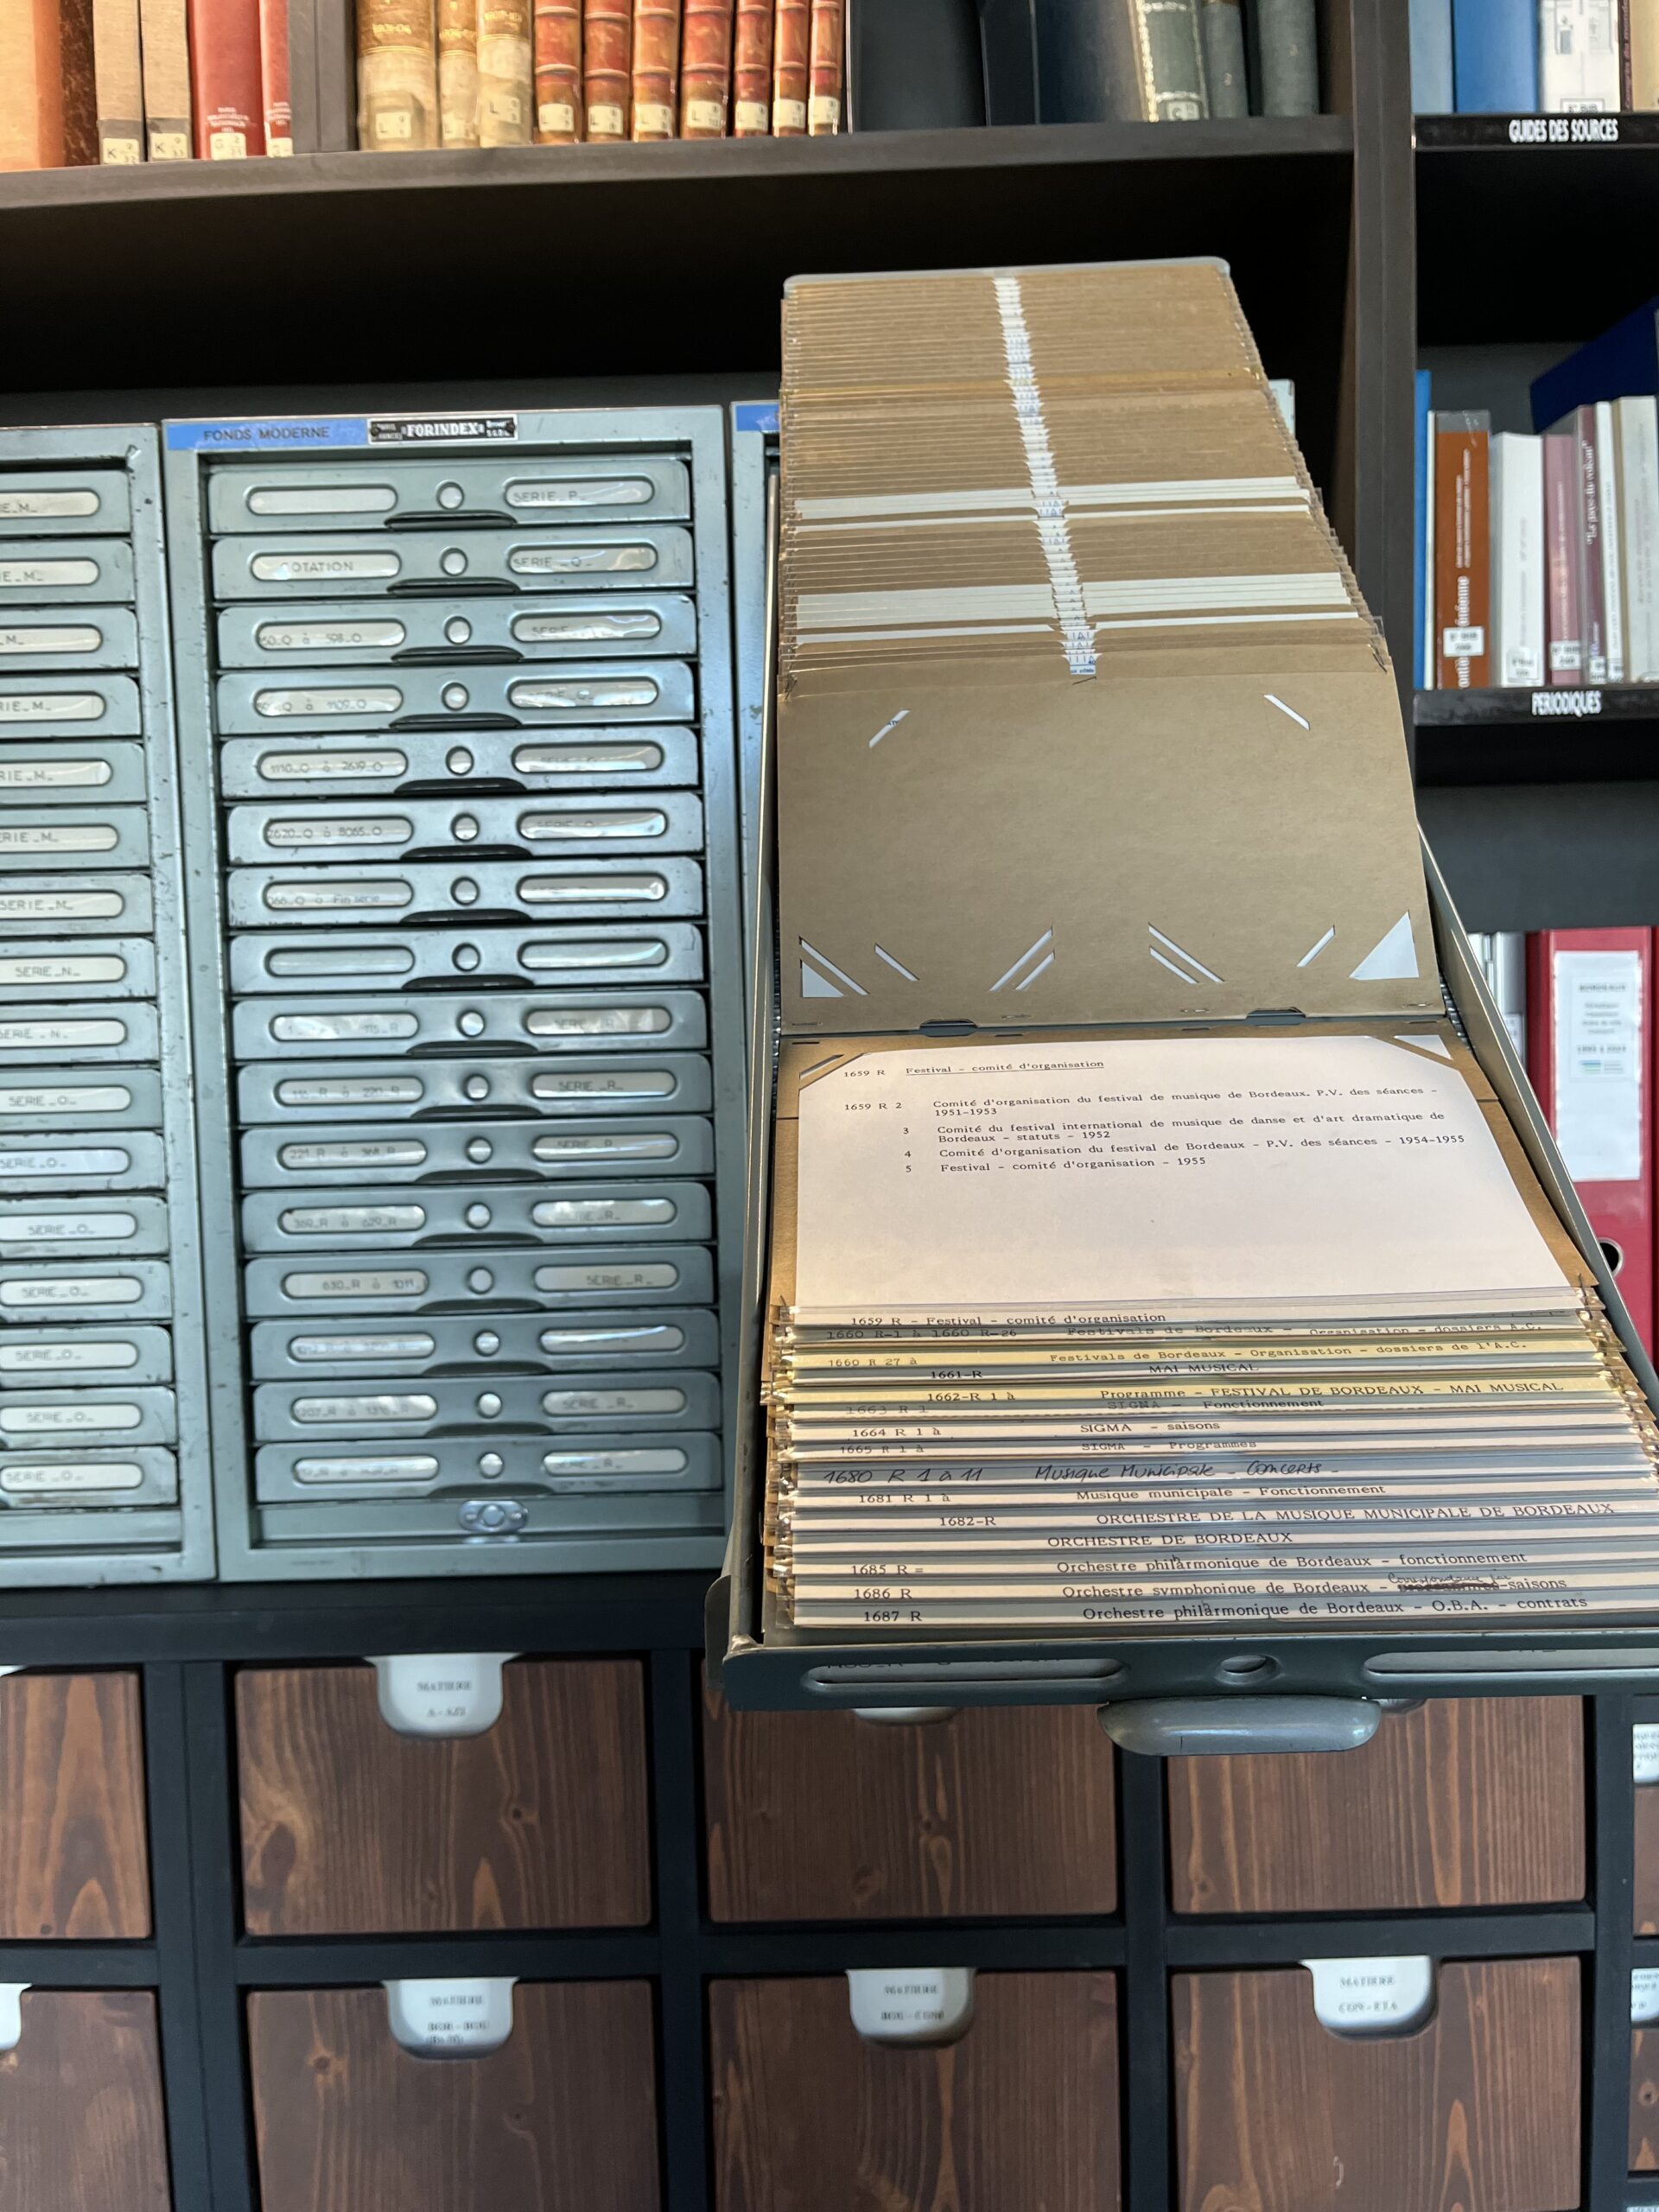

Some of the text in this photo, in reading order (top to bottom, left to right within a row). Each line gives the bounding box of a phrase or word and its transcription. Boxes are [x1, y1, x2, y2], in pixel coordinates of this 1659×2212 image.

[1509, 118, 1618, 143] GUIDES DES SOURCES
[203, 426, 330, 442] FONDS MODERNE
[406, 422, 480, 438] FORINDEX
[843, 1069, 870, 1077] 1659
[906, 1065, 951, 1075] Festival
[971, 1063, 1013, 1072] comité
[1020, 1059, 1104, 1071] d'organisation
[844, 1103, 872, 1111] 1659
[933, 1099, 977, 1109] Comité
[983, 1096, 1071, 1107] d'organisation
[1077, 1095, 1091, 1103] du
[1098, 1093, 1143, 1103] festival
[1150, 1093, 1165, 1102] de
[1171, 1091, 1221, 1102] musique
[1228, 1090, 1243, 1098] de
[1249, 1089, 1311, 1098] Bordeaux.
[1376, 1086, 1424, 1096] séances
[935, 1107, 997, 1116] 1951-1953
[937, 1125, 982, 1134] Comité
[988, 1124, 1003, 1133] du
[1010, 1122, 1055, 1132] festival
[1062, 1120, 1142, 1130] international
[1150, 1119, 1165, 1128] de
[1172, 1117, 1223, 1128] musique
[1250, 1116, 1286, 1125] danse
[1293, 1115, 1305, 1123] et
[1313, 1114, 1344, 1123] d'art
[1351, 1112, 1423, 1123] dramatique
[1429, 1111, 1445, 1120] de
[938, 1130, 1111, 1143] Bordeaux statuts 1952
[939, 1135, 1465, 1158] Comité d'organisation du festival de Bordeaux P.V. des séances 1954-1955
[940, 1156, 1206, 1173] Festival comité d'organisation 1955
[851, 1313, 1166, 1326] 1659 R Festival comité d'organisation
[829, 1358, 860, 1367] 1660
[885, 1357, 900, 1366] 27
[910, 1357, 918, 1365] à
[1050, 1352, 1125, 1362] Festivals
[1133, 1351, 1150, 1360] de
[1159, 1349, 1225, 1359] Bordeaux
[1250, 1346, 1352, 1358] Organisation
[1376, 1344, 1444, 1353] dossiers
[1452, 1342, 1469, 1351] de
[931, 1363, 1260, 1379] 1661-R MAI MUSICAL
[927, 1382, 1565, 1402] 1662-R 1 à Programme FESTIVAL DE BORDEAUX MAI MUSICAL
[852, 1428, 886, 1438] 1664
[916, 1427, 924, 1436] 1
[932, 1427, 942, 1436] à
[1080, 1423, 1133, 1433] SIGMA
[1166, 1421, 1220, 1431] saisons
[823, 1469, 873, 1484] 1680
[887, 1468, 906, 1484] R
[916, 1468, 931, 1482] 1
[960, 1468, 983, 1482] 11
[1034, 1465, 1110, 1483] Musique
[1121, 1462, 1216, 1478] Municipale
[859, 1484, 1386, 1503] 1681 R 1 à Musique municipale Fonctionnement
[939, 1503, 1615, 1527] 1682-R ORCHESTRE DE LA MUSIQUE MUNICIPALE DE BORDEAUX
[1047, 1532, 1294, 1548] ORCHESTRE DE BORDEAUX
[850, 1564, 887, 1575] 1685
[897, 1564, 909, 1575] R
[1057, 1560, 1137, 1573] Orchestre
[1268, 1556, 1287, 1567] de
[1296, 1555, 1372, 1567] Bordeaux
[1399, 1552, 1528, 1566] fonctionnement
[853, 1588, 891, 1599] 1686
[900, 1588, 912, 1599] R
[1062, 1586, 1143, 1599] Orchestre
[1153, 1582, 1256, 1596] symphonique
[1265, 1582, 1285, 1594] de
[1293, 1580, 1370, 1594] Bordeaux
[864, 1610, 899, 1622] 1687
[910, 1610, 923, 1622] R
[1083, 1606, 1165, 1620] Orchestre
[1300, 1602, 1318, 1615] de
[1327, 1600, 1405, 1614] Bordeaux
[1431, 1599, 1490, 1612] O.B.A.
[1516, 1596, 1588, 1610] contrats
